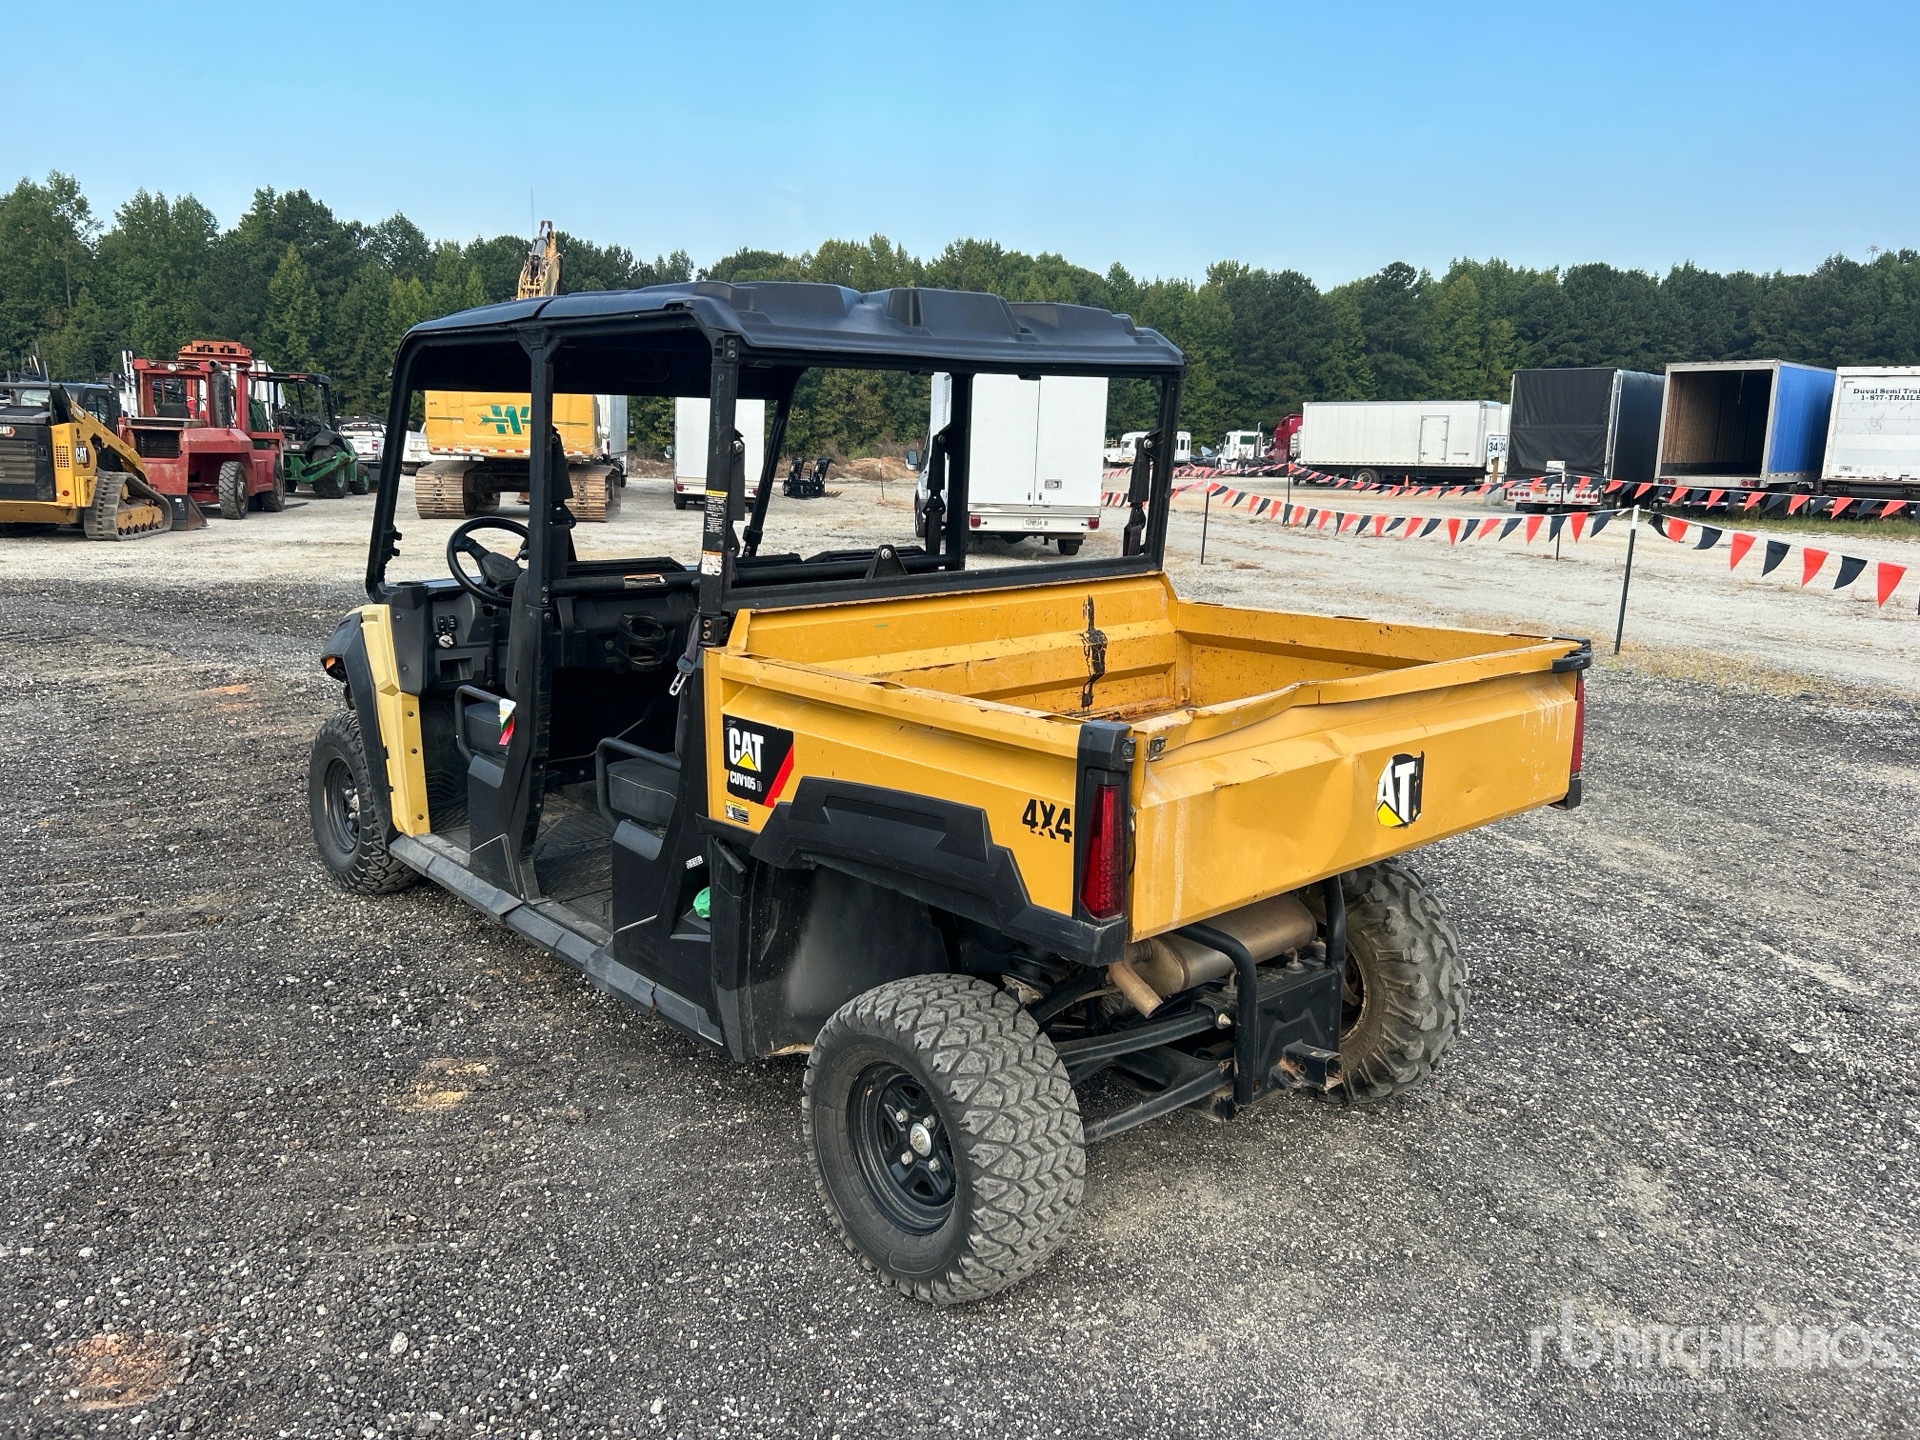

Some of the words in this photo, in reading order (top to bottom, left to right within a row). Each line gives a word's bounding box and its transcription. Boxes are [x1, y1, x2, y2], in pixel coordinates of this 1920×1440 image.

[75, 446, 88, 464] CAT
[1488, 442, 1498, 452] 34
[728, 727, 764, 773] CAT
[730, 770, 756, 791] CUV105
[1022, 798, 1073, 844] 4X4
